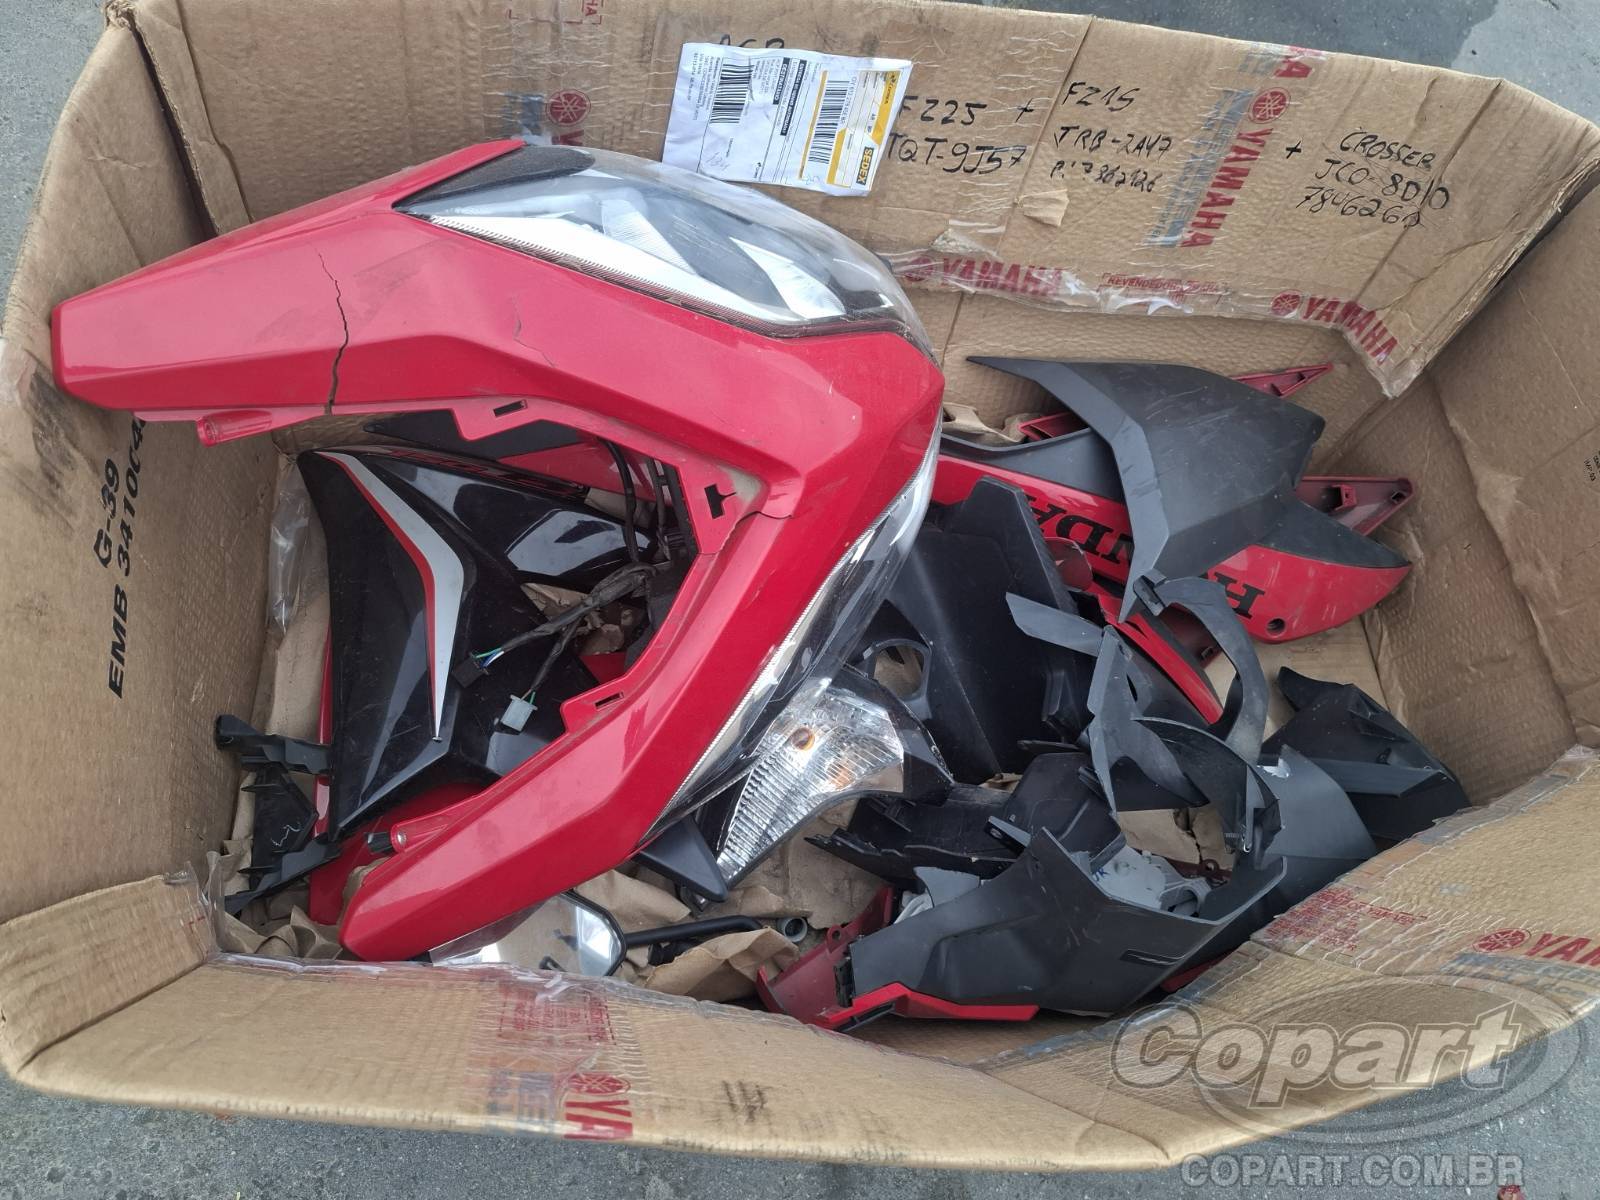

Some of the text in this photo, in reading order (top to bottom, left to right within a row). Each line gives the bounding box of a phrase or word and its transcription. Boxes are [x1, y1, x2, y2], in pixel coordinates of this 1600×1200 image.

[857, 147, 873, 184] SEDEX
[1180, 127, 1275, 248] YAMAHA
[1339, 130, 1437, 171] CROSSER
[1301, 296, 1399, 367] YAMAHA
[93, 458, 120, 568] G-39
[108, 583, 128, 699] EMB
